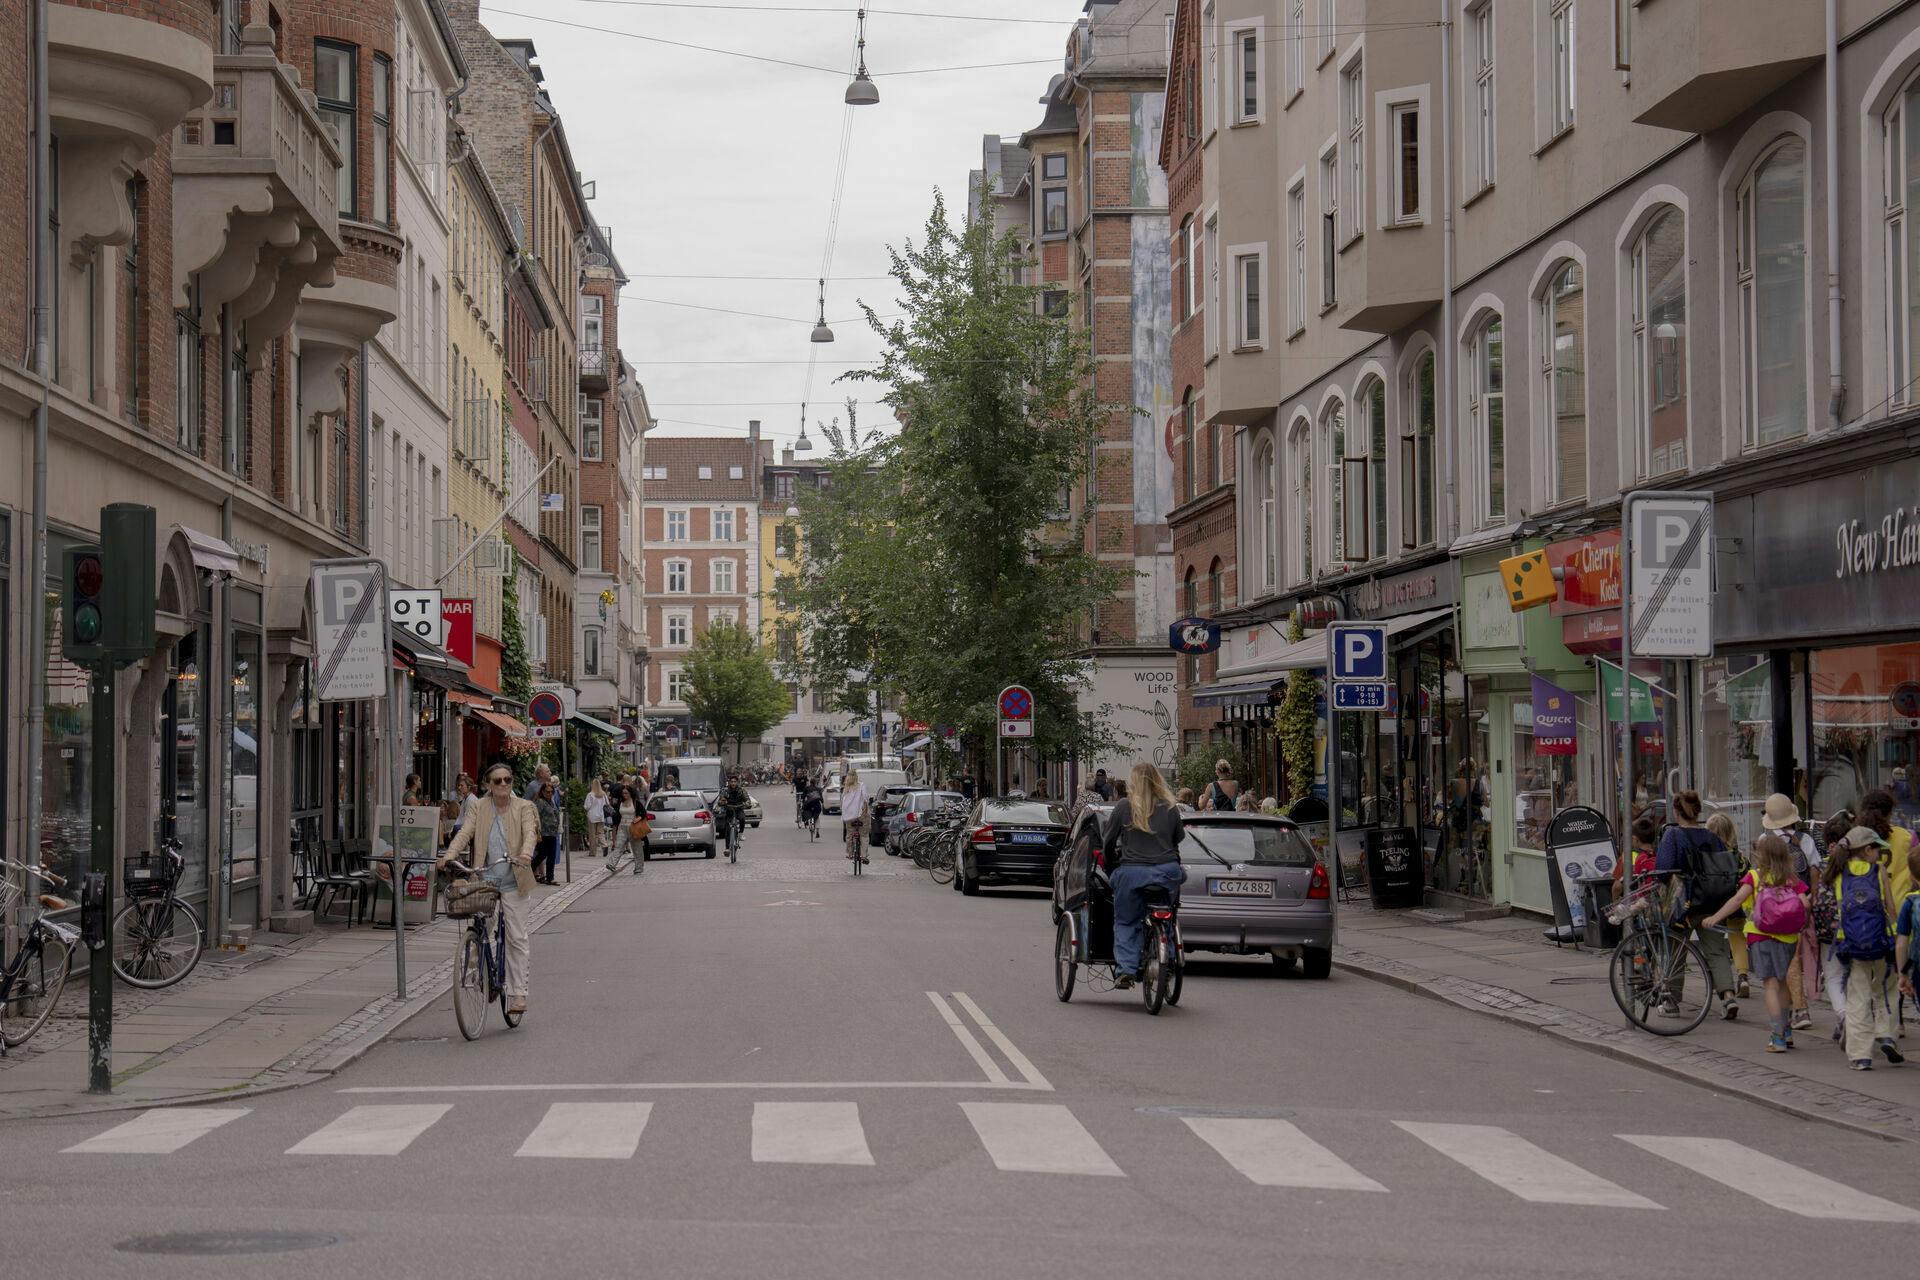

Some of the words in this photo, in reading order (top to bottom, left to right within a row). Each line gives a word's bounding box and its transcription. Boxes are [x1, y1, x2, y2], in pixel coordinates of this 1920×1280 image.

[1656, 516, 1690, 563] P
[1836, 519, 1879, 579] New
[1582, 541, 1614, 578] Cherry
[1600, 576, 1619, 603] Kiosk
[335, 579, 364, 620] P
[394, 599, 430, 615] OT
[1345, 634, 1373, 672] P
[1134, 672, 1174, 682] WOOD
[1536, 715, 1572, 727] QUICK
[1540, 737, 1572, 745] LOTTO
[1562, 823, 1594, 834] company
[1567, 820, 1588, 828] water
[1379, 847, 1410, 860] TEELING
[1219, 881, 1234, 892] CG
[1235, 882, 1249, 892] 74
[1250, 882, 1270, 893] 882
